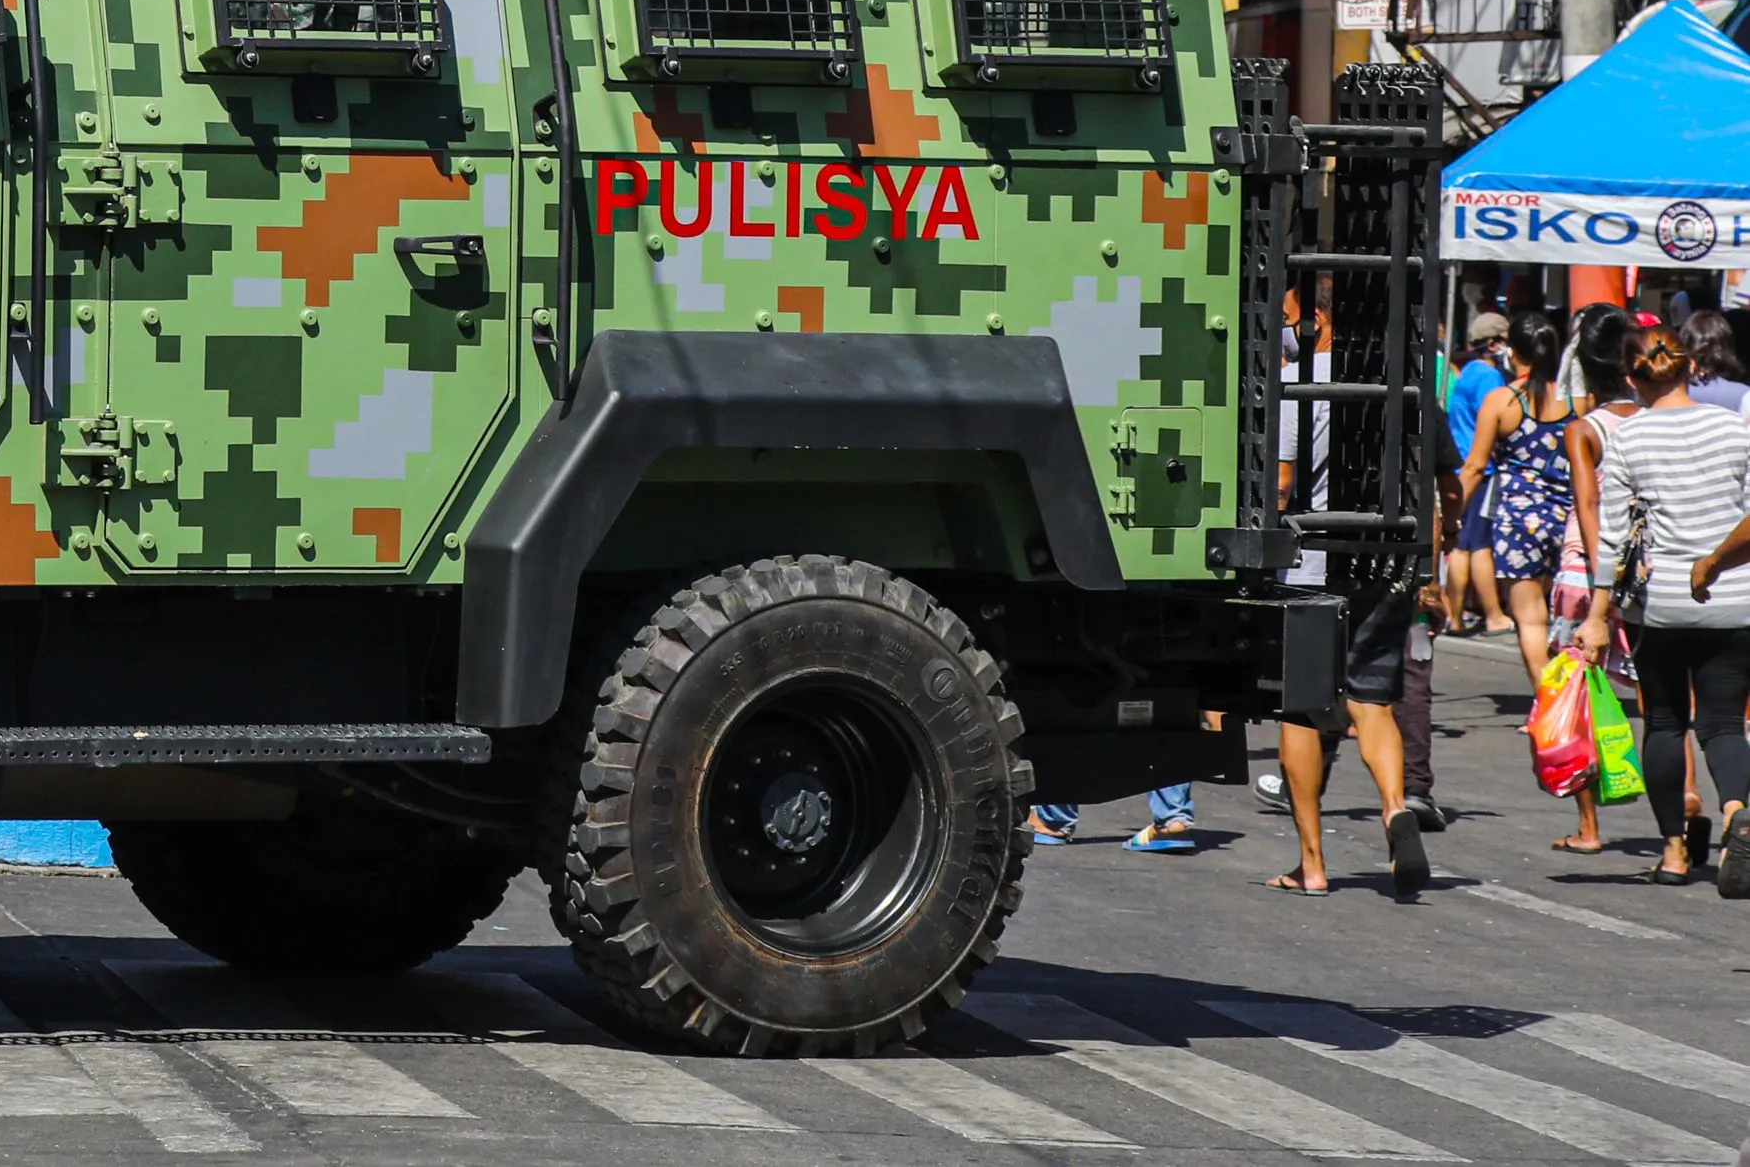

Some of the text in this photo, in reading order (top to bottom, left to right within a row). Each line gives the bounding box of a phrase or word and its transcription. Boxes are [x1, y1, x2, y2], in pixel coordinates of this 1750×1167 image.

[1347, 6, 1377, 18] BOTH
[596, 158, 981, 241] PULISYA
[1455, 193, 1541, 207] MAYOR
[1454, 205, 1641, 246] ISKO
